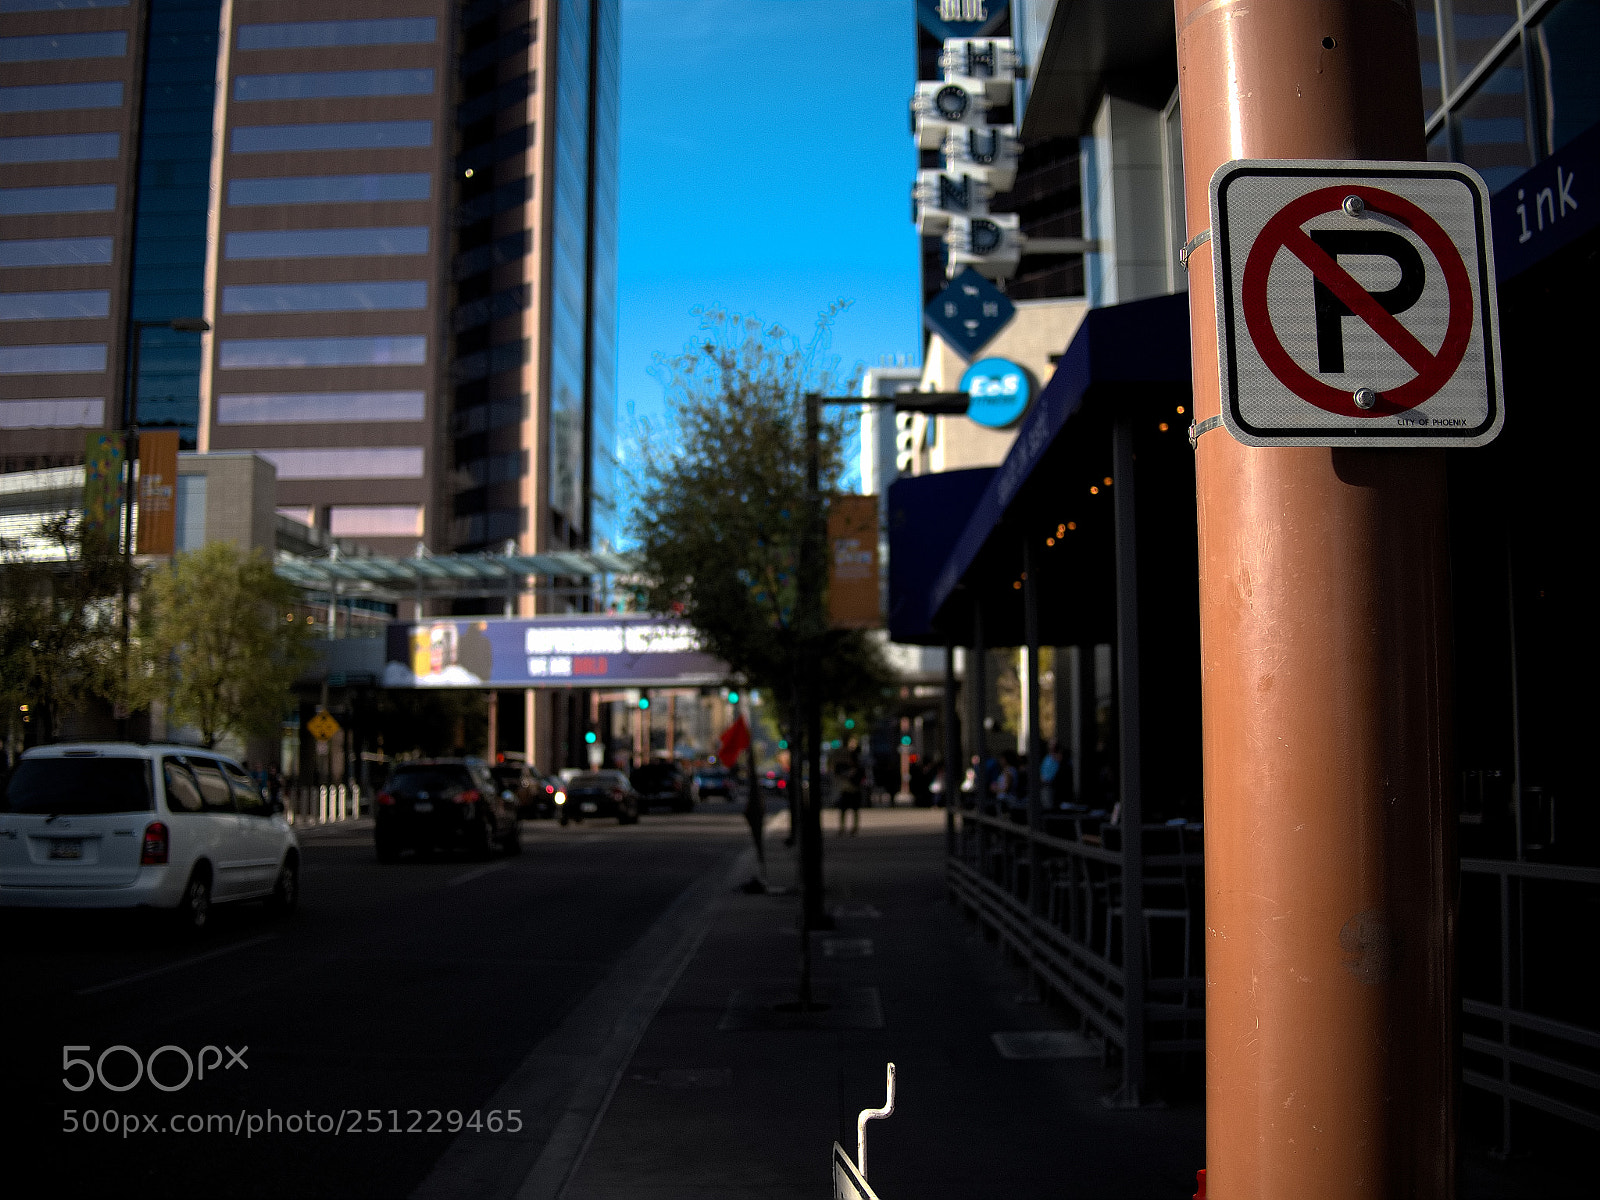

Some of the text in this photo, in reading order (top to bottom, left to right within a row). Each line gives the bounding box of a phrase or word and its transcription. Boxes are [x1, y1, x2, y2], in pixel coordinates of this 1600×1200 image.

[1516, 166, 1578, 244] ink
[1310, 229, 1426, 374] P
[1397, 418, 1467, 426] CITY OF PHOENIX
